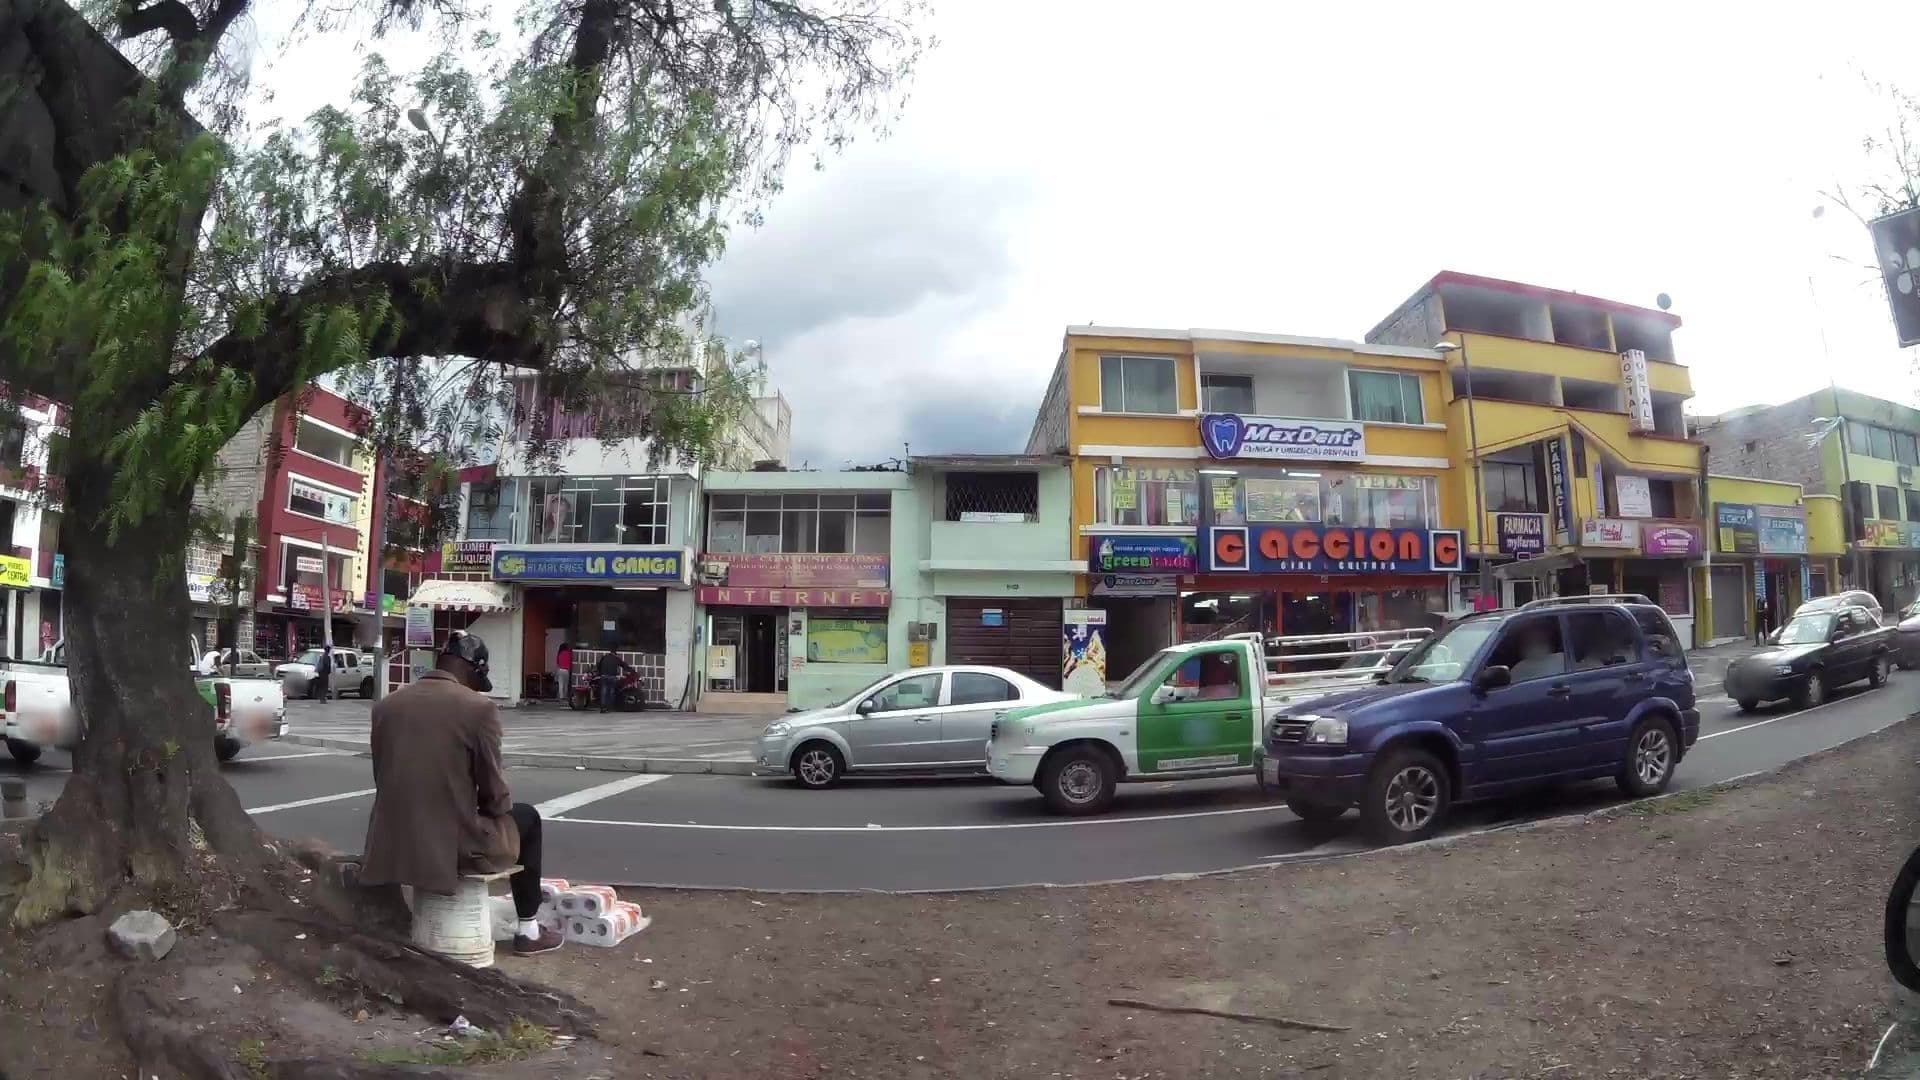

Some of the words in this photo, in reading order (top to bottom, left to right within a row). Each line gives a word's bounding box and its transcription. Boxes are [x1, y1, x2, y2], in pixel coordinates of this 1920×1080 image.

[1622, 352, 1636, 419] HOSTAL
[1244, 424, 1354, 446] MexDent
[1550, 441, 1565, 529] FARMACIA
[585, 556, 605, 574] LA
[612, 557, 677, 574] GANGA
[700, 589, 889, 607] INTERNET
